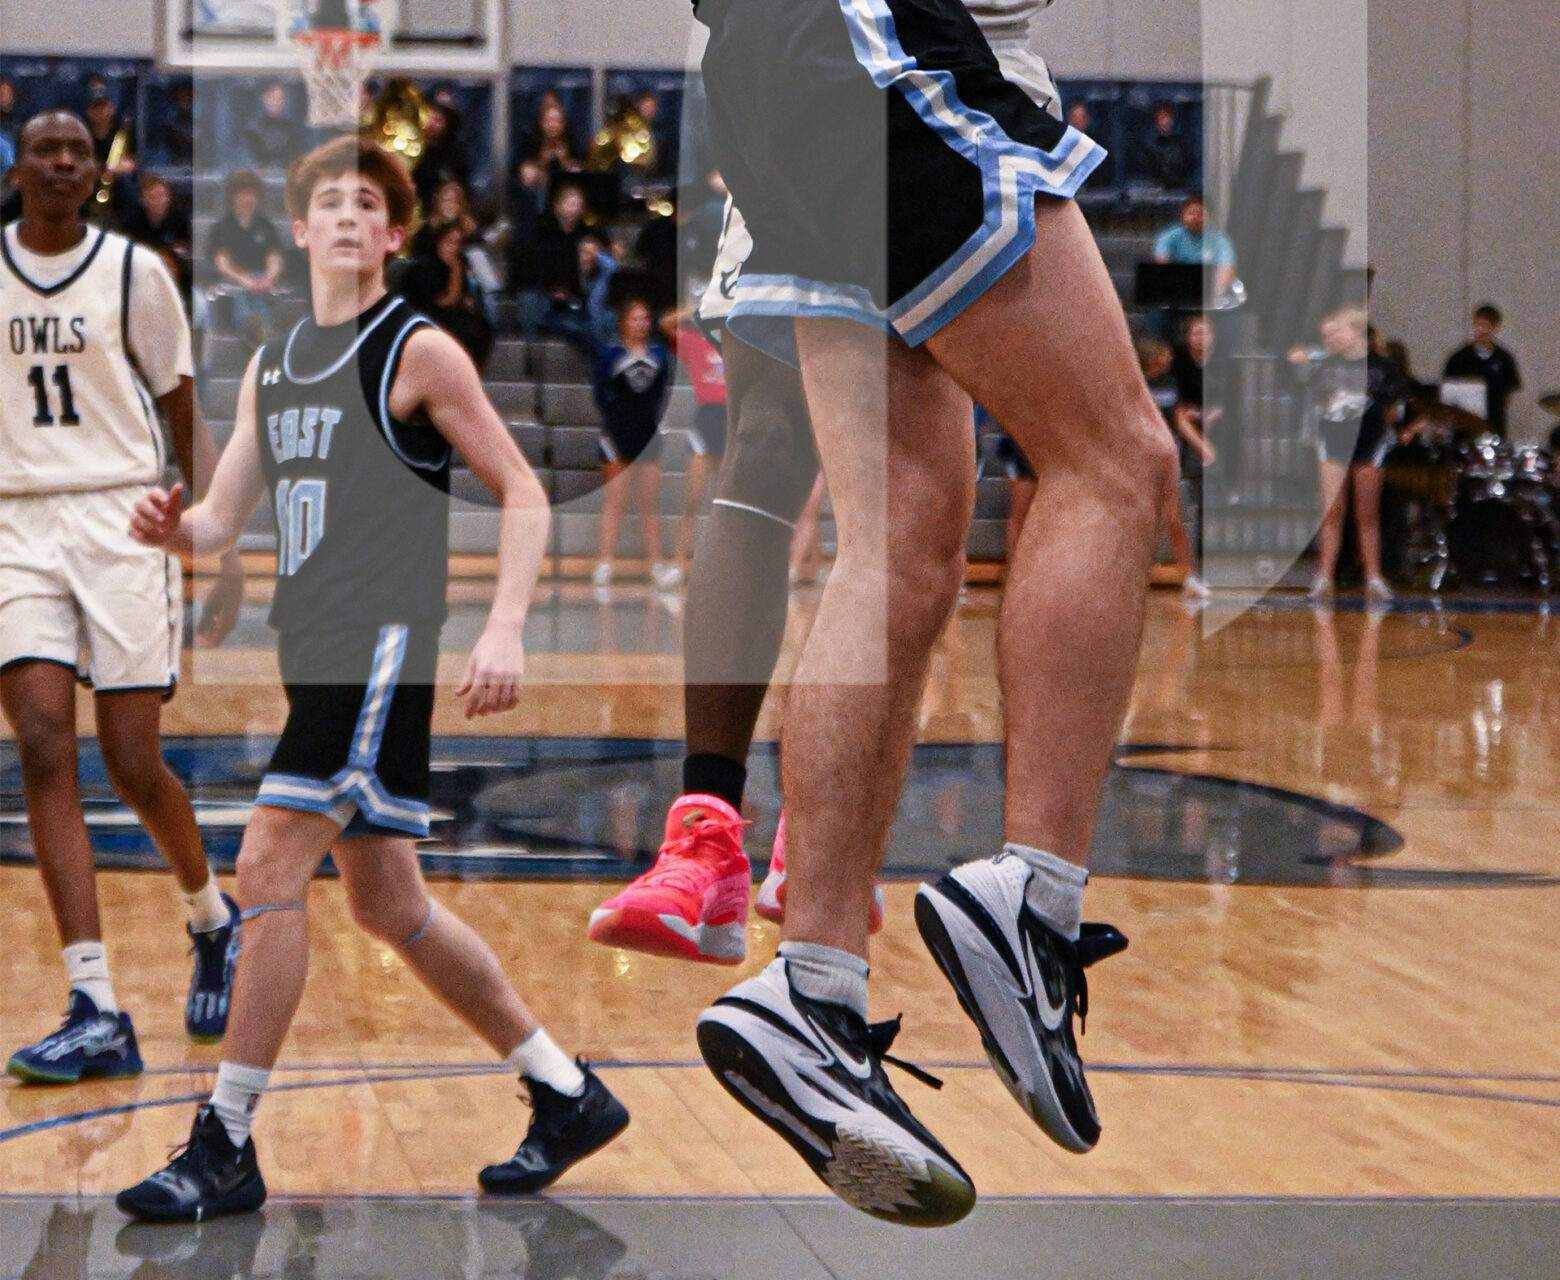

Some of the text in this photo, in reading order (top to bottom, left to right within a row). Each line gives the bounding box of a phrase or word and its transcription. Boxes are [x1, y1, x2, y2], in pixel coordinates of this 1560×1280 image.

[8, 316, 86, 356] OWLS
[28, 363, 81, 428] 11
[266, 406, 343, 465] EAST
[275, 478, 327, 577] 10
